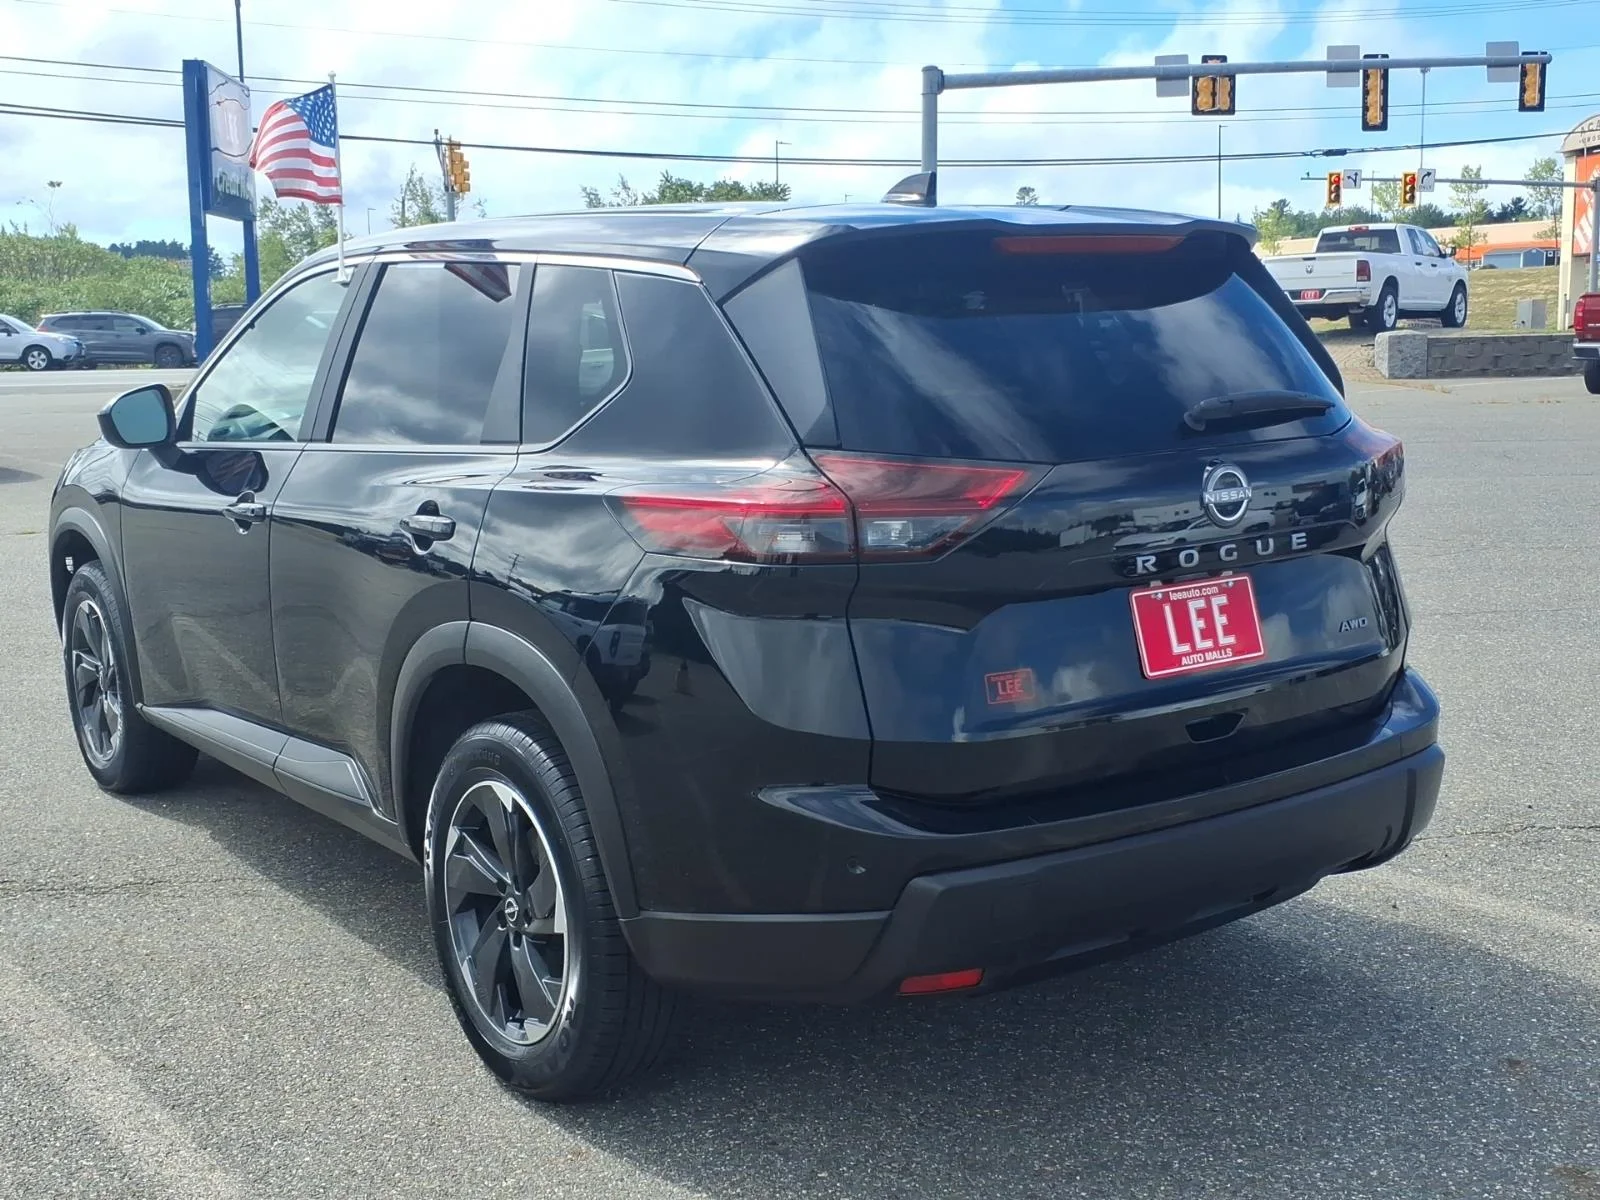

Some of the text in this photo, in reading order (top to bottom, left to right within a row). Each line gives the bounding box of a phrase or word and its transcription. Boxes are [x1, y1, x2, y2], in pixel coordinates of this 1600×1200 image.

[1205, 488, 1252, 503] NISSAN
[1136, 532, 1308, 574] ROGUE
[1169, 586, 1219, 600] leeauto.com
[1163, 594, 1237, 655] LEE
[1338, 616, 1369, 632] AWD
[1181, 647, 1233, 666] AUTO MALLS
[997, 678, 1025, 695] LEE
